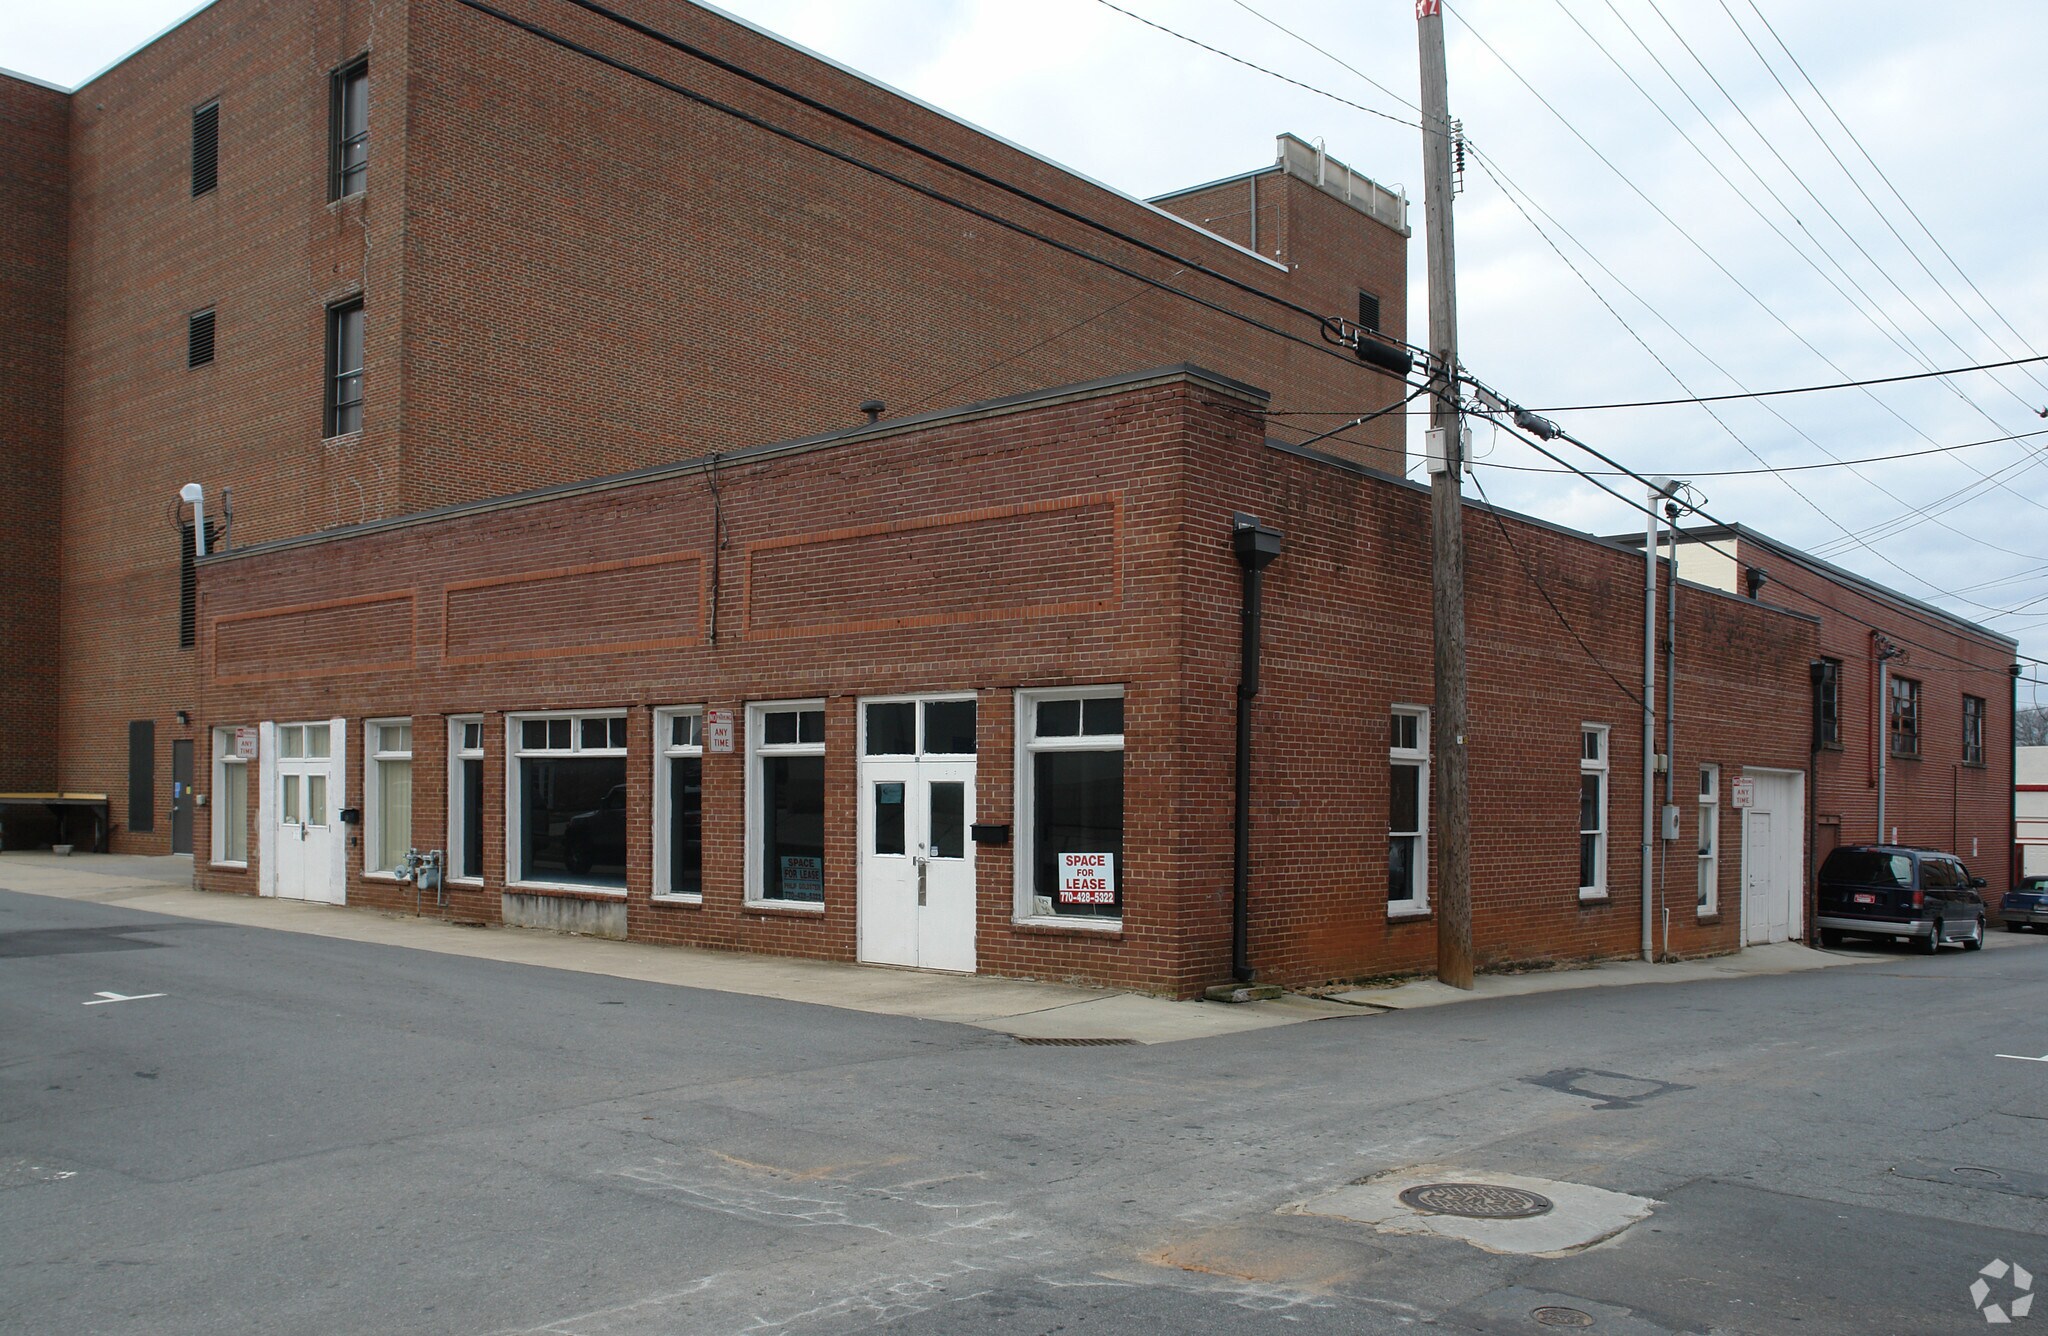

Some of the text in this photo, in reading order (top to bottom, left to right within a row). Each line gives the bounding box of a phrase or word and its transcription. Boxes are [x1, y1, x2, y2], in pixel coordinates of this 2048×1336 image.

[715, 728, 728, 737] ANY
[714, 738, 729, 748] TIME
[788, 858, 815, 867] SPACE
[1066, 855, 1105, 866] SPACE
[784, 869, 820, 879] FOR LEASE
[1076, 868, 1094, 877] FOR
[1066, 879, 1106, 890] LEASE
[1060, 892, 1114, 903] 770-428-5322
